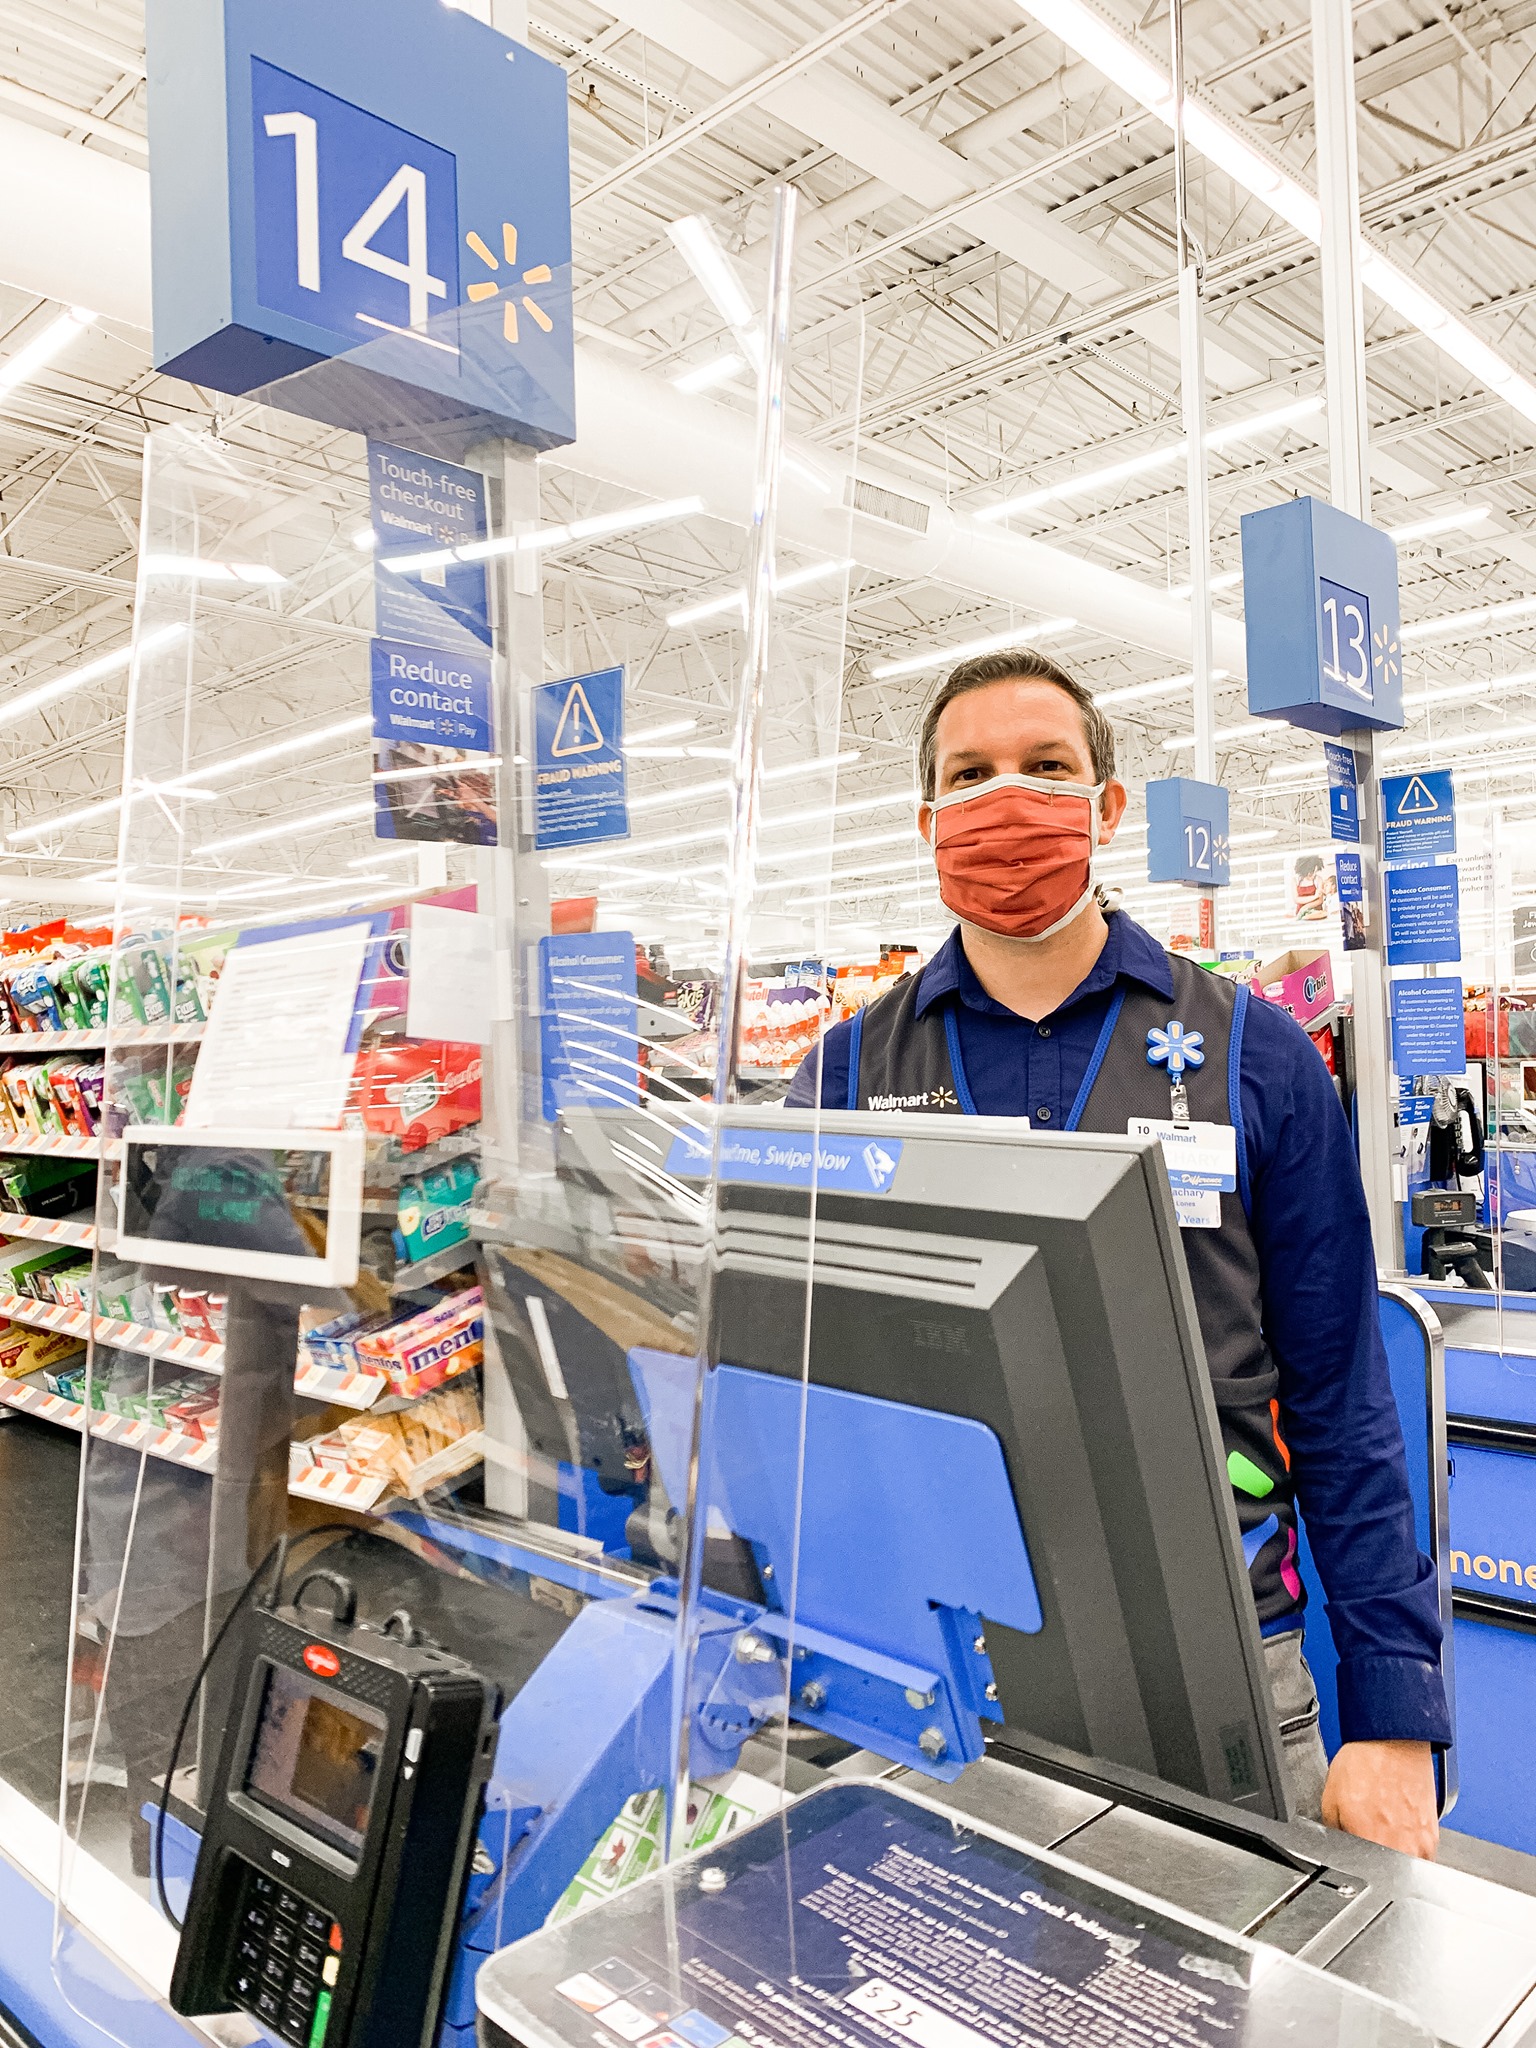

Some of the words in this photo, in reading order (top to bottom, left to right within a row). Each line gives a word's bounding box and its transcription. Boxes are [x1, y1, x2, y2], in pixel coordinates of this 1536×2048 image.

[262, 111, 447, 328] 14
[377, 453, 477, 502] Touch-free
[380, 481, 465, 520] checkout
[380, 510, 433, 536] Walmart
[1323, 597, 1370, 690] 13
[389, 654, 473, 690] Reduce
[389, 688, 475, 716] contact
[389, 713, 436, 731] Walmart
[458, 723, 478, 739] Pay
[1326, 749, 1353, 766] Touch-free
[537, 769, 571, 786] FRAUD
[571, 759, 622, 780] WARNING
[1328, 763, 1351, 777] checkout
[1386, 820, 1412, 829] FRAUD
[1414, 814, 1453, 826] WARNING
[1184, 825, 1210, 870] 12
[1339, 859, 1358, 872] Reduce
[1464, 852, 1502, 863] unlimitd
[1340, 873, 1359, 885] contact
[1391, 888, 1416, 896] Tobacco
[1418, 884, 1452, 893] Consumer:
[1397, 904, 1416, 912] provide
[1417, 902, 1430, 911] proof
[1446, 901, 1454, 909] by
[1421, 911, 1438, 919] proper
[1390, 938, 1412, 946] purchase
[1433, 936, 1457, 944] products.
[549, 955, 580, 967] Alcohol
[580, 955, 625, 965] Consumer:
[1303, 971, 1328, 1005] Orbit
[1422, 988, 1455, 996] Consumer:
[678, 988, 704, 1010] akis
[868, 1092, 929, 1111] Walmart
[1137, 1125, 1150, 1135] 10
[1156, 1131, 1197, 1144] Walmart
[764, 1145, 812, 1172] Swipe
[1181, 1173, 1223, 1186] Difference
[1183, 1215, 1211, 1225] Years
[1020, 1891, 1066, 1918] Check
[865, 1986, 883, 1998] $
[875, 1999, 922, 2027] 25
